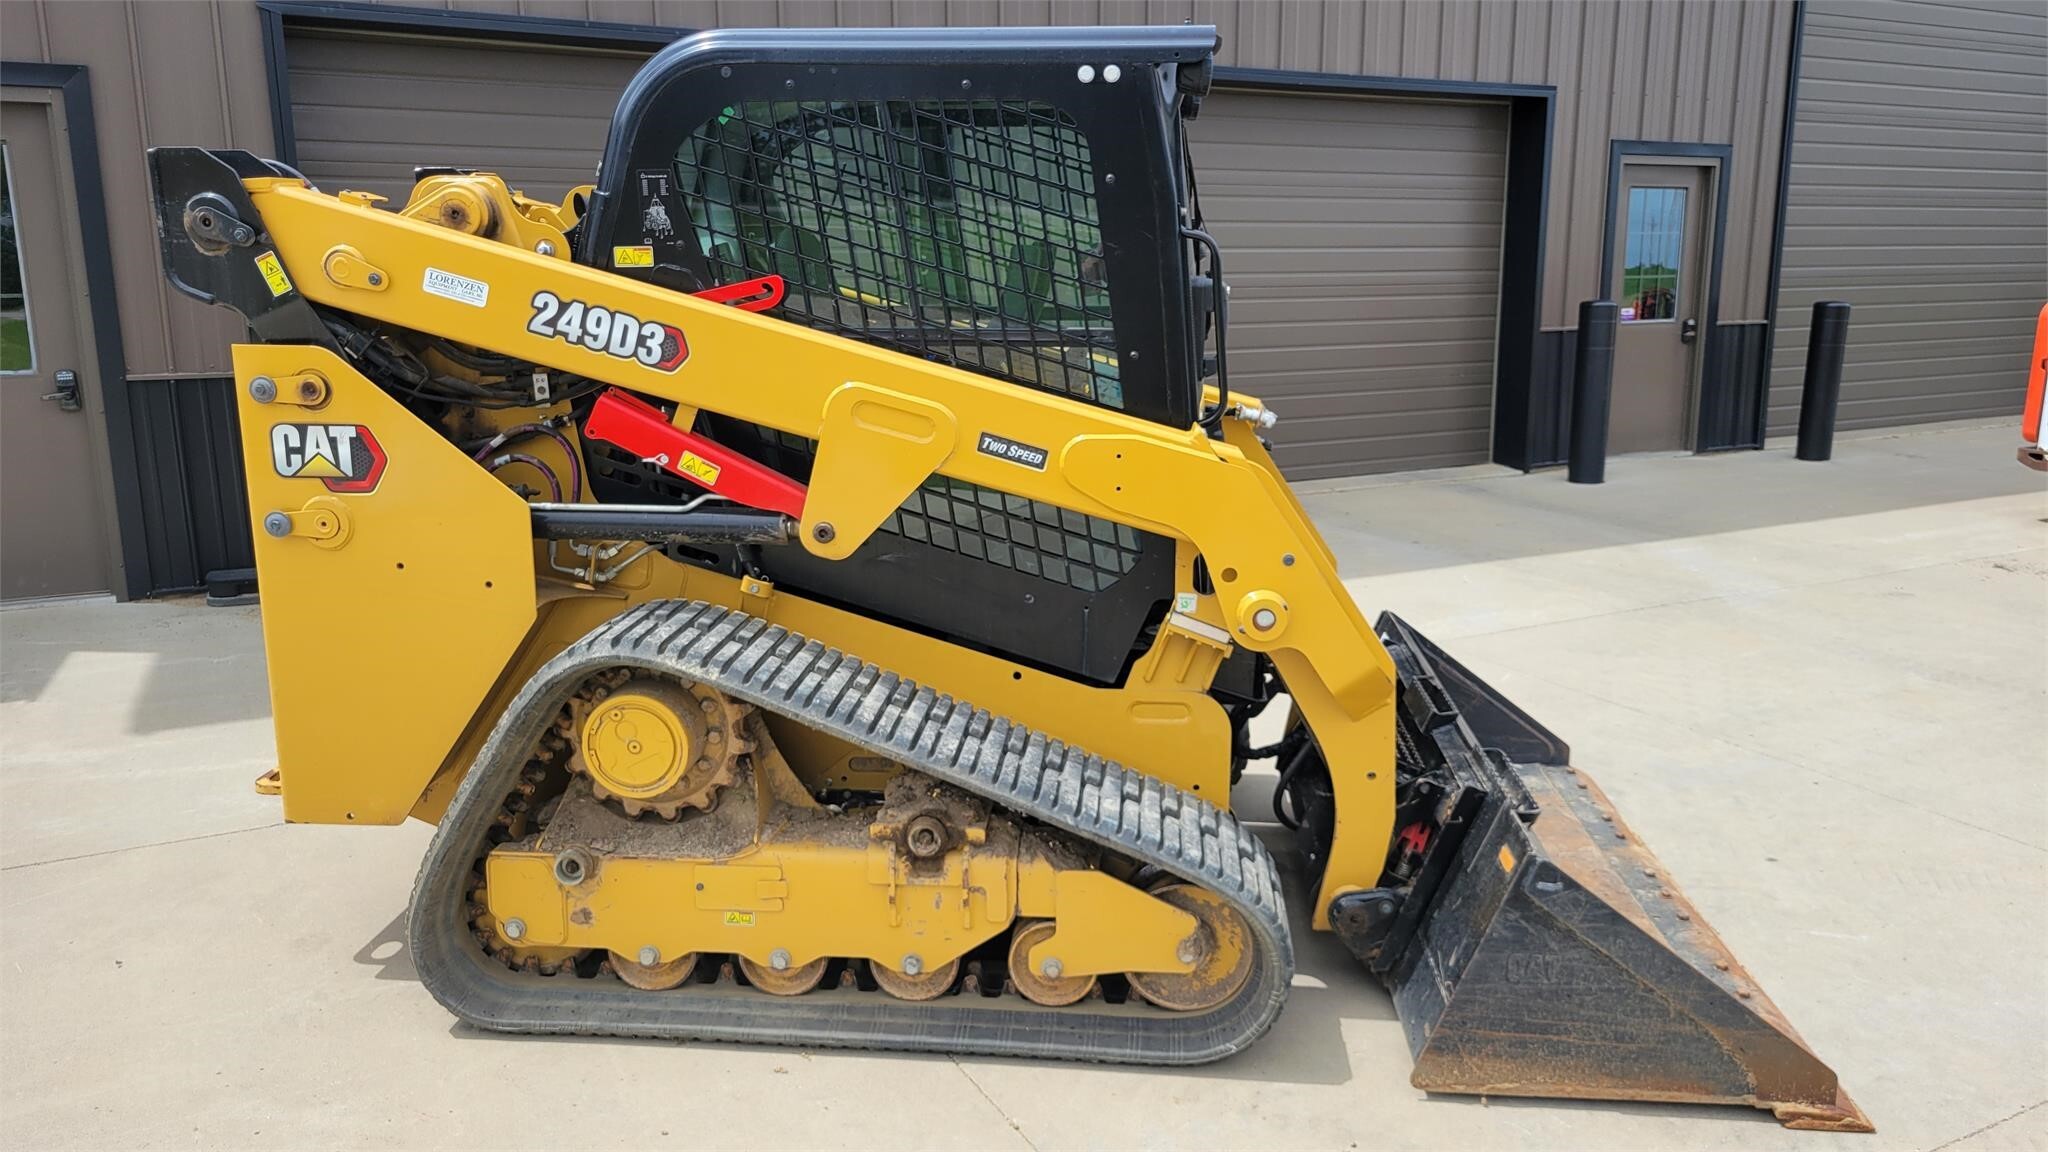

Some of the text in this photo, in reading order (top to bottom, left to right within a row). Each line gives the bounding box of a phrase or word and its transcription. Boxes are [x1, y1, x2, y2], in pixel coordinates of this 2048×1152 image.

[429, 272, 485, 294] LORENZEN
[529, 292, 666, 365] 249D3
[272, 424, 357, 477] CAT
